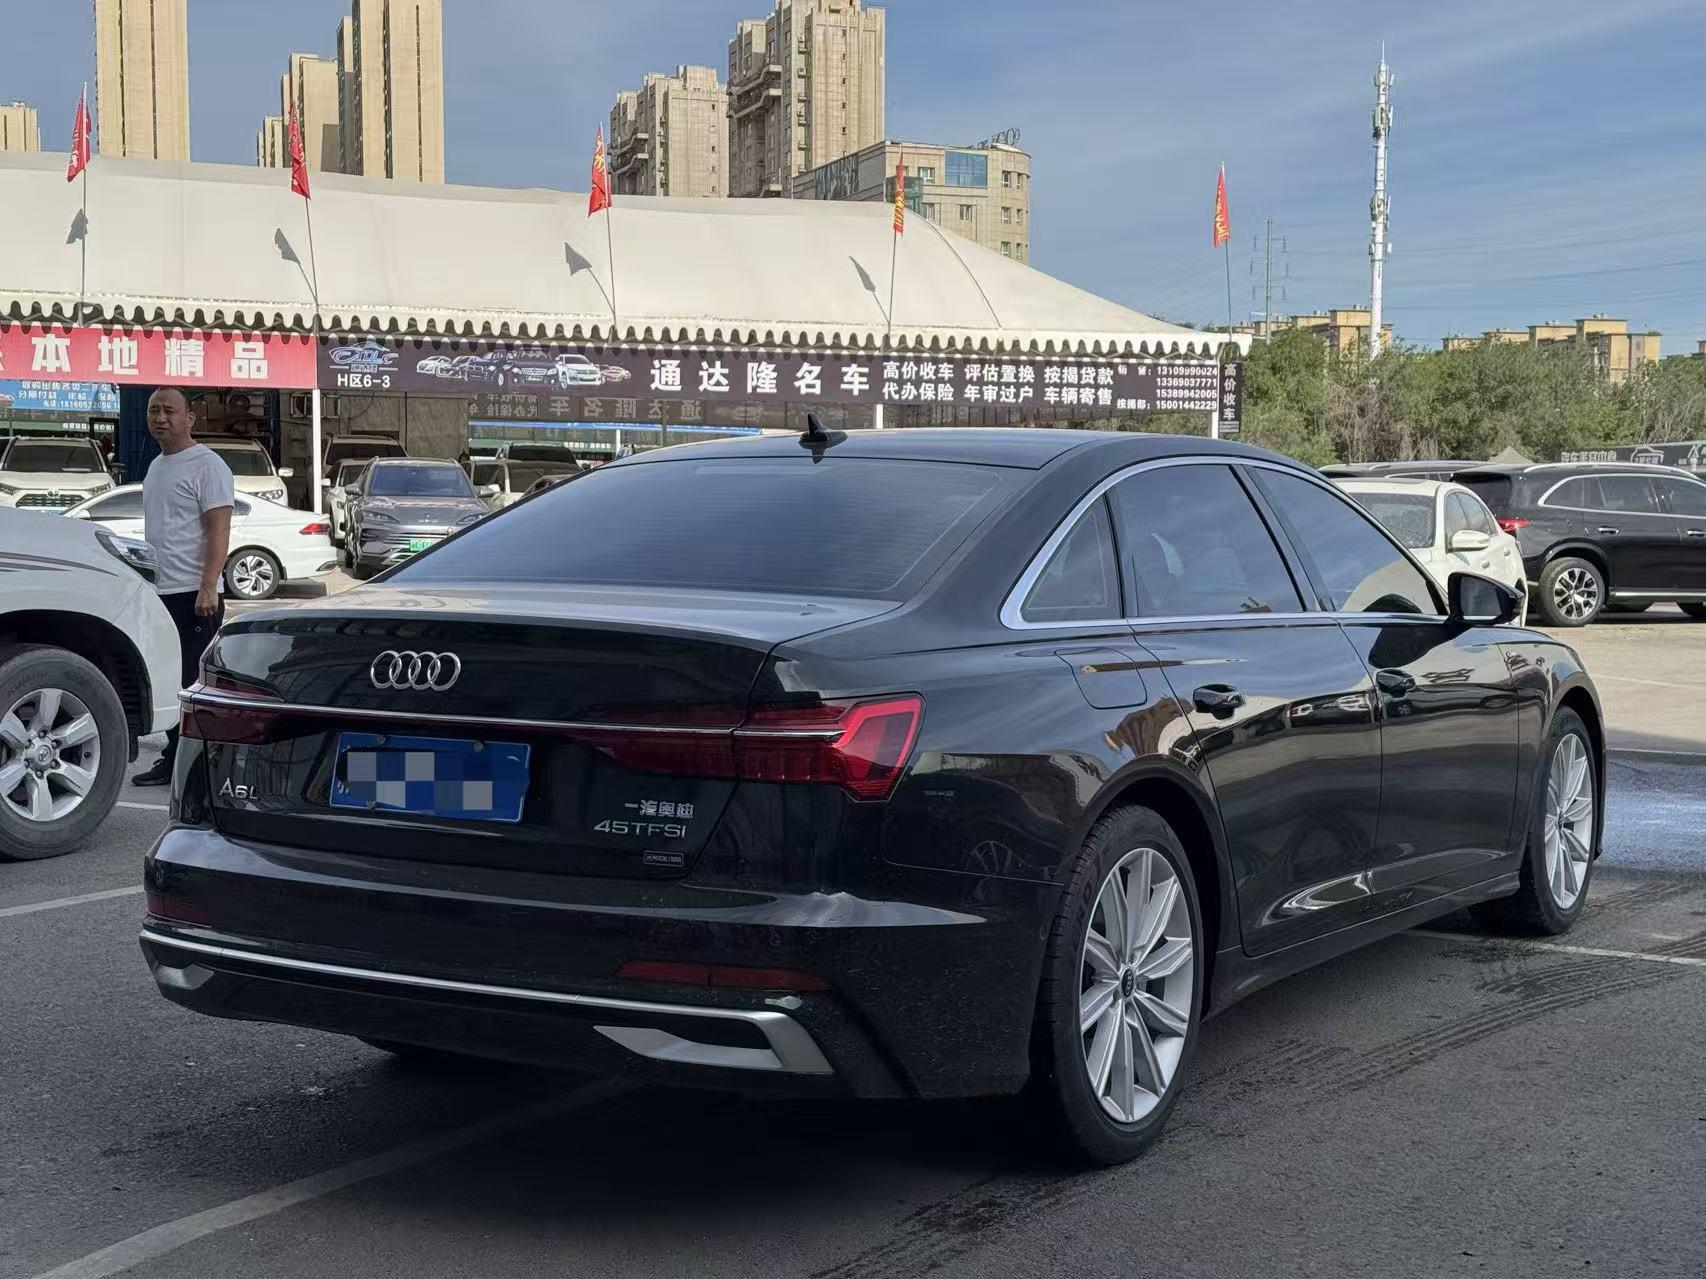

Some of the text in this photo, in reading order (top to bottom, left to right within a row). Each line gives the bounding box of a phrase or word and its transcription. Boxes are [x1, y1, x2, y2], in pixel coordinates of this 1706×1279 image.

[0, 333, 269, 379] 本地精品
[337, 373, 392, 388] H区6-3
[650, 359, 870, 396] 通达隆名车
[883, 361, 1115, 384] 高价收车 评估置换 按揭贷款
[1156, 366, 1218, 376] 13109990024
[1156, 377, 1218, 388] 13369037771
[1222, 363, 1238, 421] 高价收车
[882, 382, 1114, 406] 代办保险 年审过户 车辆寄售
[1156, 389, 1218, 399] 15389942005
[1156, 400, 1218, 410] 15001442229
[218, 777, 259, 800] A6L
[624, 799, 694, 819] 一汽奥迪
